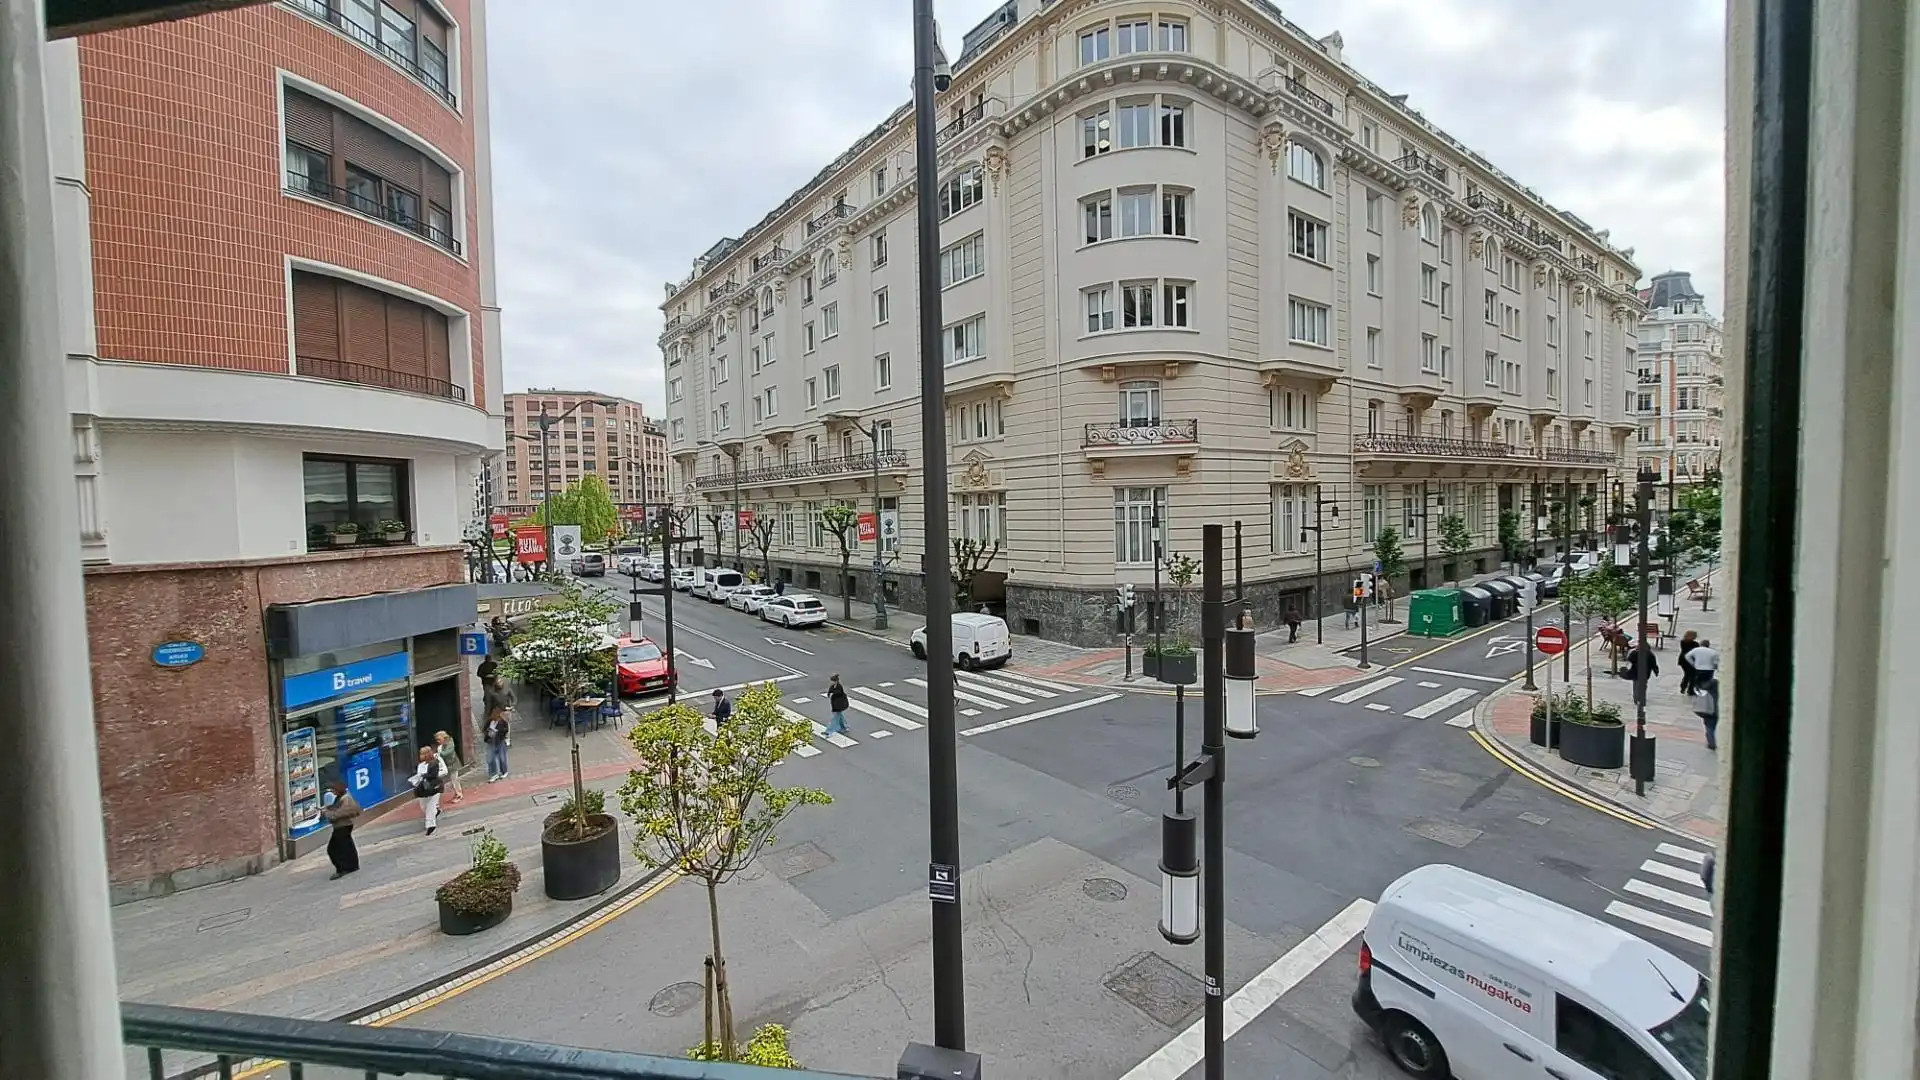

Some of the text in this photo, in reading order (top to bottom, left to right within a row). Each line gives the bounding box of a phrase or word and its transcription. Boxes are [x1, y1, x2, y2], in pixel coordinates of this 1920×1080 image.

[518, 537, 538, 546] RUTH
[519, 544, 544, 554] ASAWA
[466, 637, 478, 652] B
[333, 672, 373, 691] B travel
[355, 767, 370, 790] B
